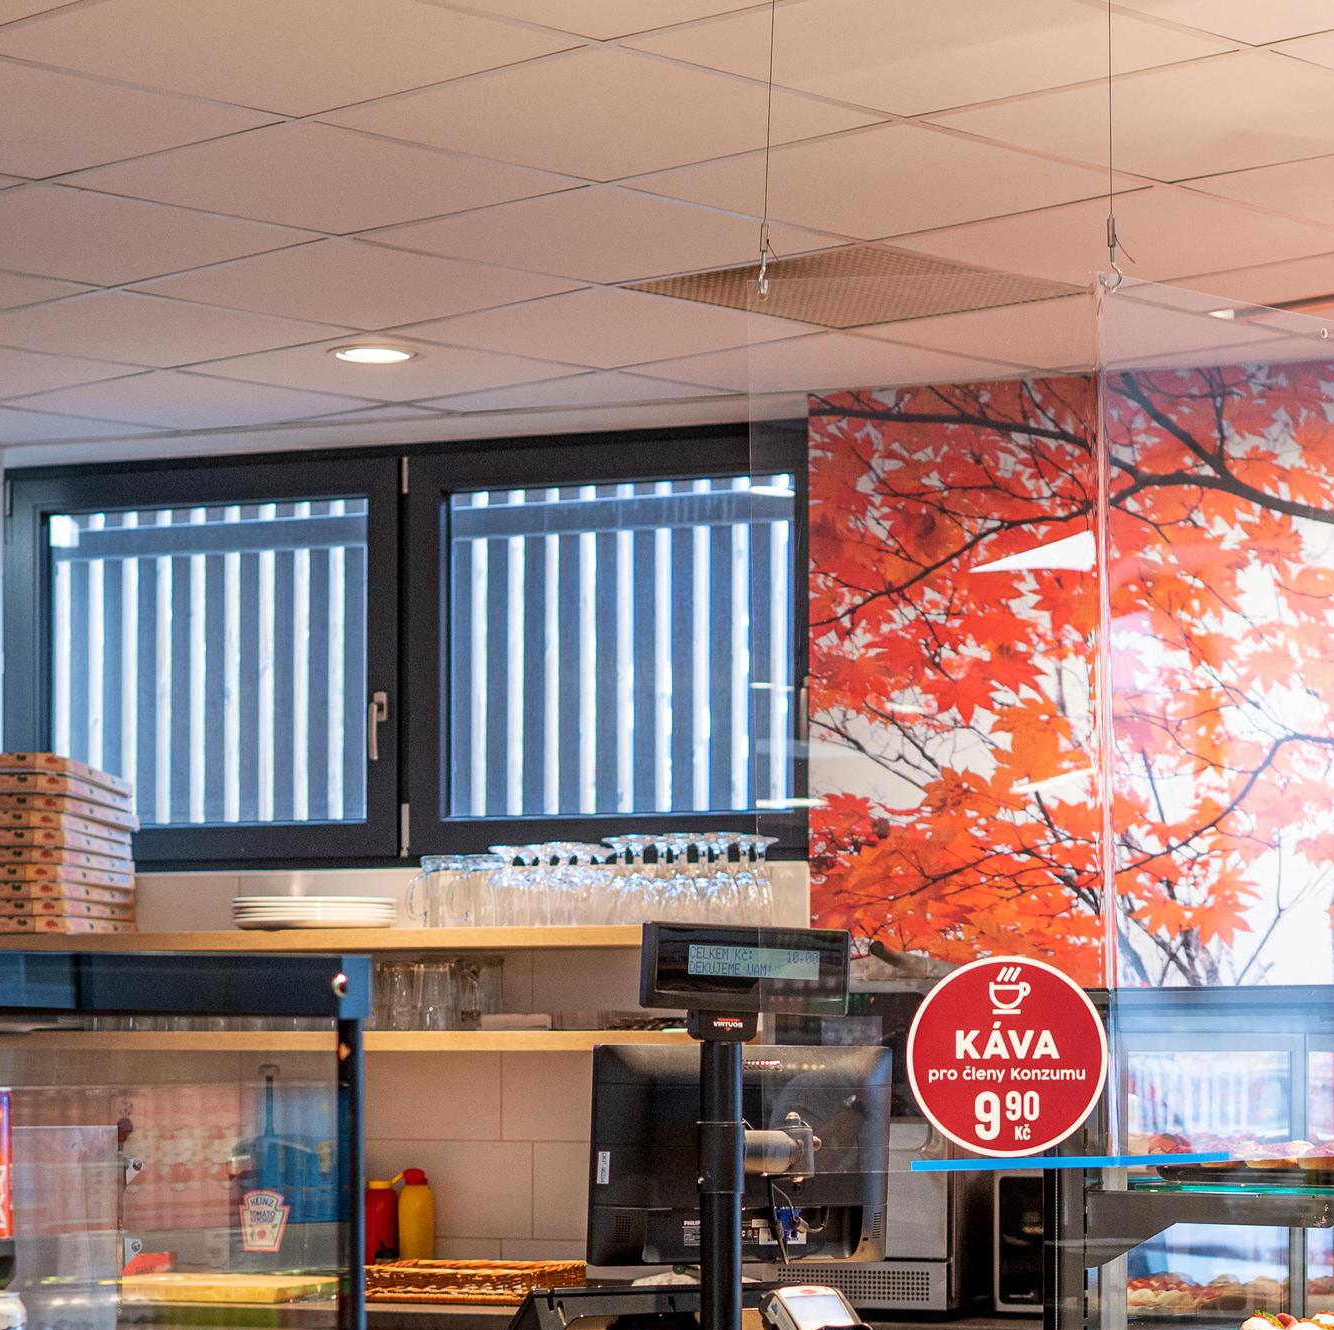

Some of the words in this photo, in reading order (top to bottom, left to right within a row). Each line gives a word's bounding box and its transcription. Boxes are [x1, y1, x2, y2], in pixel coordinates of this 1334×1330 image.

[690, 945, 729, 960] CELKEM
[955, 1020, 1060, 1060] KÁVA
[928, 1067, 958, 1083] pro
[962, 1066, 1006, 1083] členy
[1014, 1124, 1031, 1141] Kč
[250, 1197, 274, 1207] HEINZ
